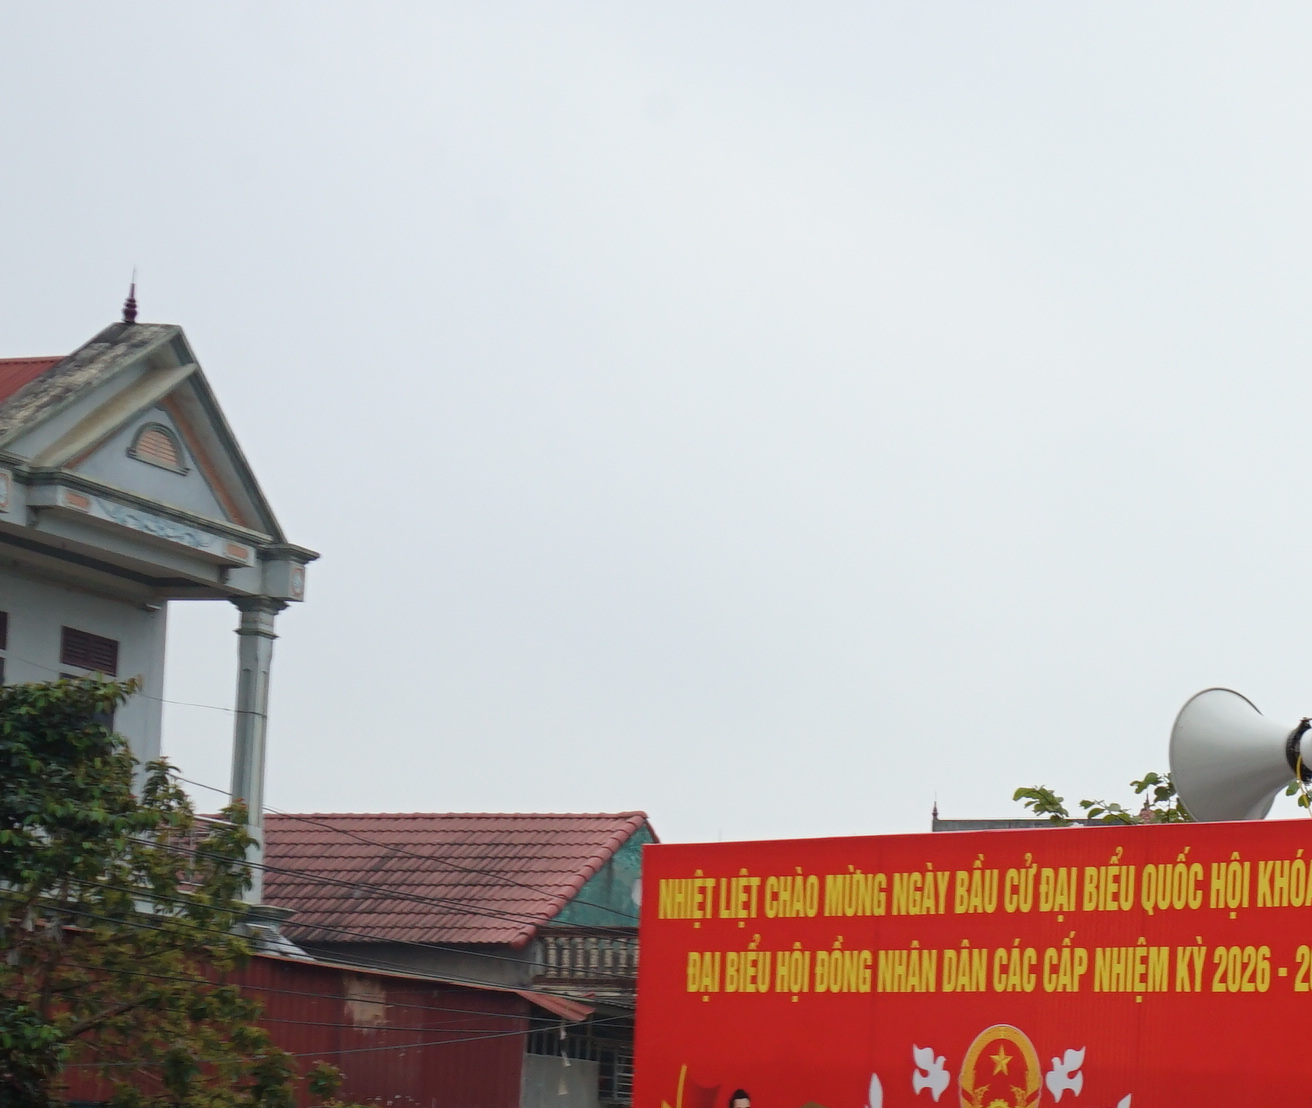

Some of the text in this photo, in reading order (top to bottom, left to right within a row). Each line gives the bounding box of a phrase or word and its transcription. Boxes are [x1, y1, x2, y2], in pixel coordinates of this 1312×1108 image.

[659, 870, 716, 928] NHIỆT
[719, 868, 761, 928] LIỆT
[765, 867, 819, 918] CHÀO
[824, 865, 887, 916] MỪNG
[892, 863, 950, 915] NGÀY
[954, 854, 999, 913] BẦU
[1004, 853, 1037, 913] CỬ
[1039, 867, 1077, 922] ĐẠI
[1083, 846, 1135, 911] BIỂU
[1141, 847, 1203, 915] QUỐC
[1210, 852, 1250, 919] HỘI
[687, 952, 721, 1002] ĐẠI
[725, 934, 771, 993] BIỂU
[775, 942, 810, 1002] HỘI
[815, 936, 872, 993] ĐỒNG
[877, 940, 937, 992] NHÂN
[942, 939, 987, 992] DÂN
[993, 938, 1037, 992] CÁC
[1043, 931, 1088, 992] CẤP
[1094, 937, 1169, 1002] NHIỆM
[1176, 936, 1207, 992] KỲ
[1212, 946, 1271, 992] 2026
[1278, 968, 1287, 976] -
